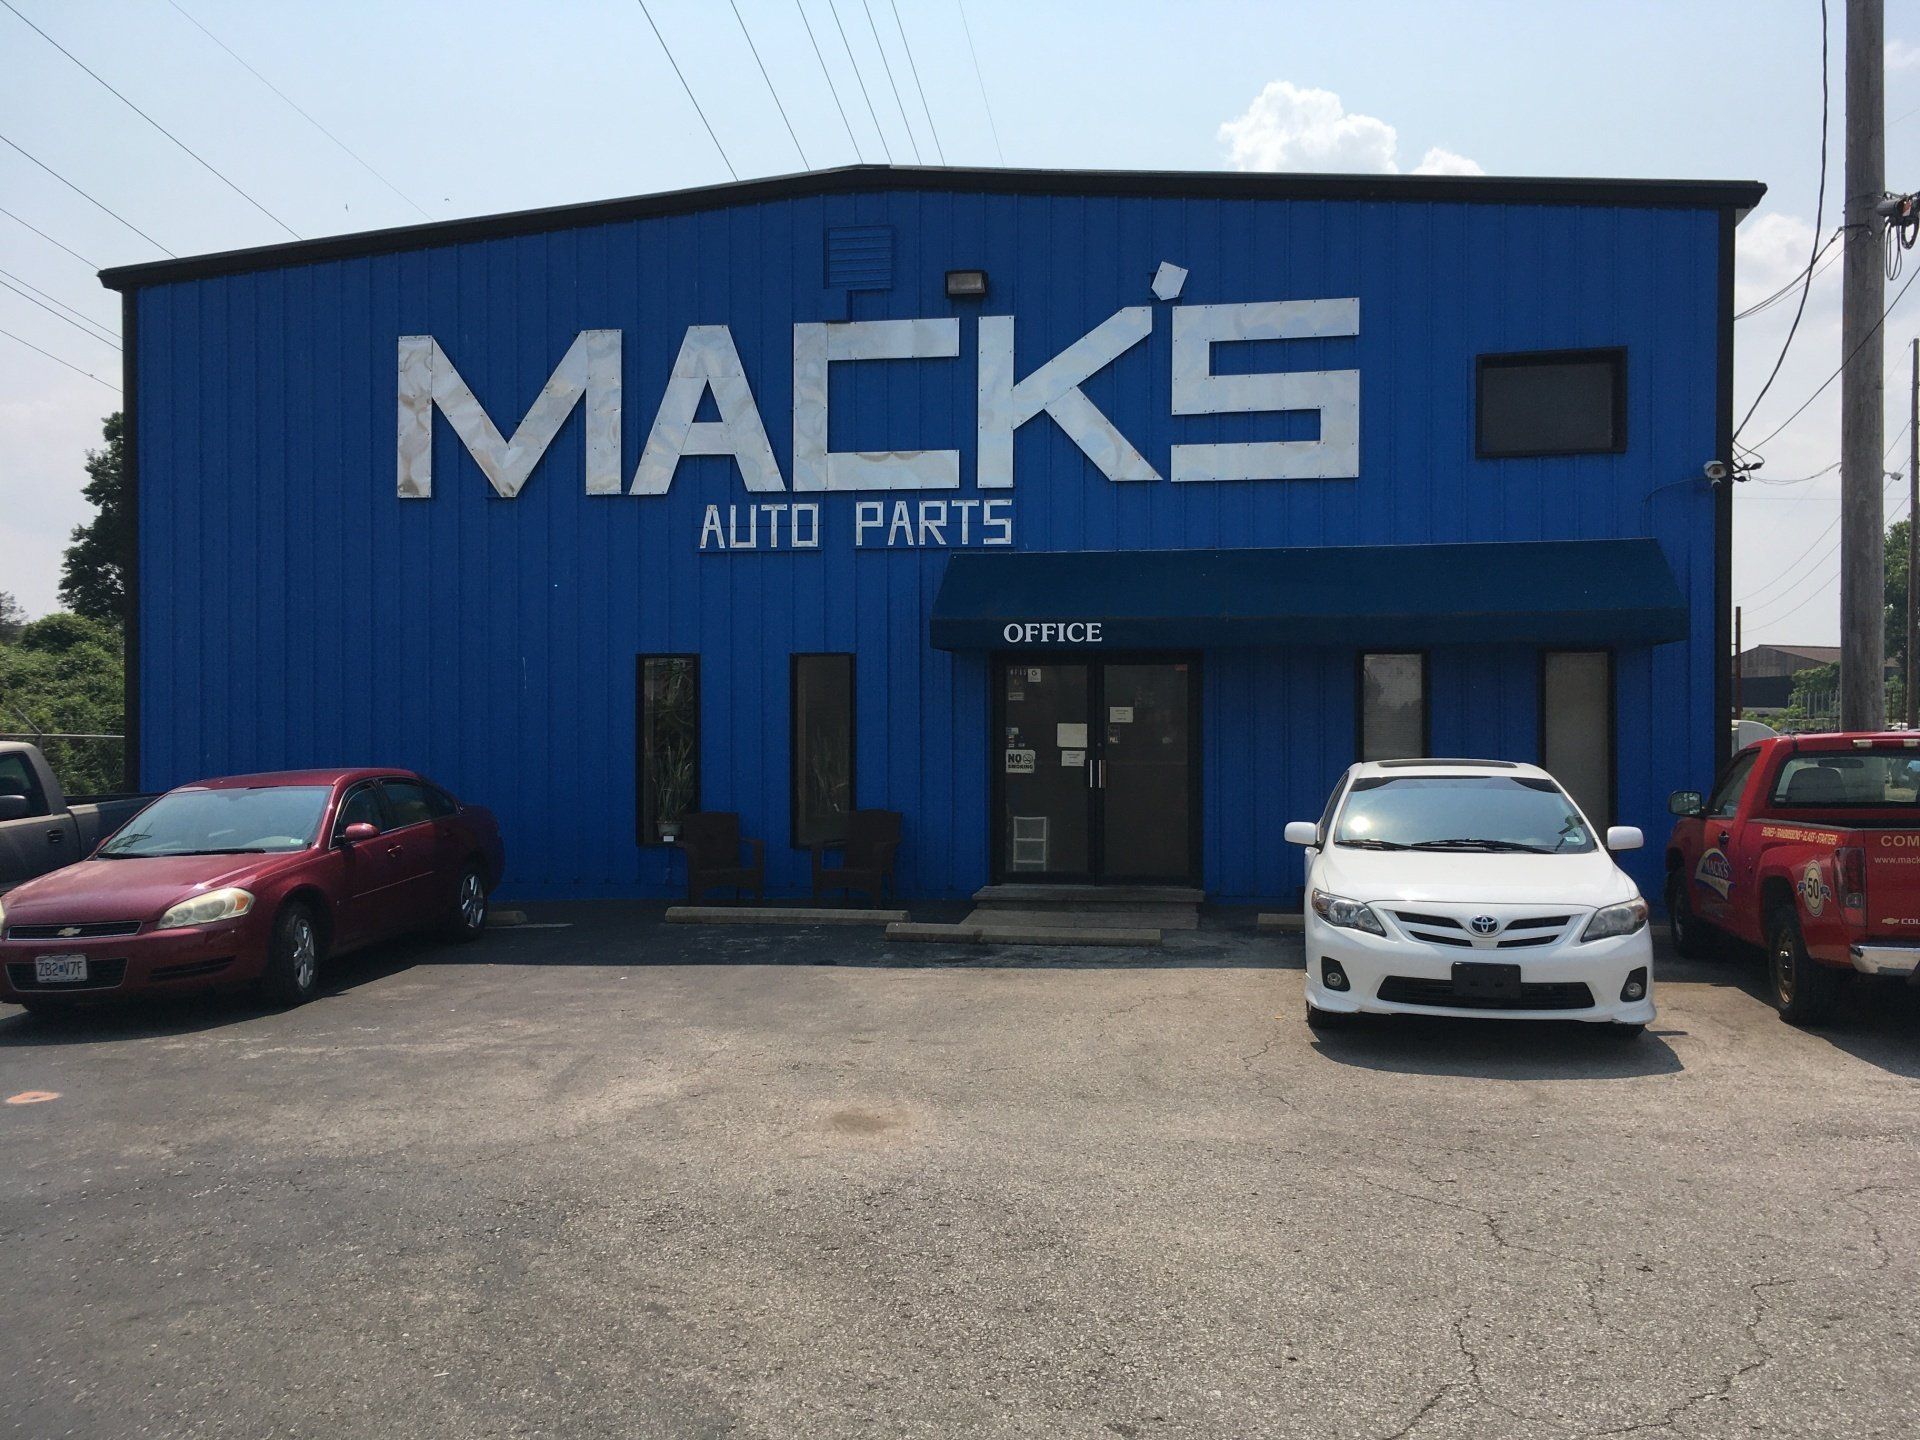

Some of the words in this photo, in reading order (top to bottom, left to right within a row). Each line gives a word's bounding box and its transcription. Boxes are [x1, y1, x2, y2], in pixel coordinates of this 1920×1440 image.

[397, 262, 1360, 499] MACK'S
[700, 503, 819, 549] AUTO
[855, 499, 1012, 546] PARTS
[1003, 622, 1103, 643] OFFICE
[1008, 753, 1022, 763] NO
[1807, 877, 1819, 899] 50
